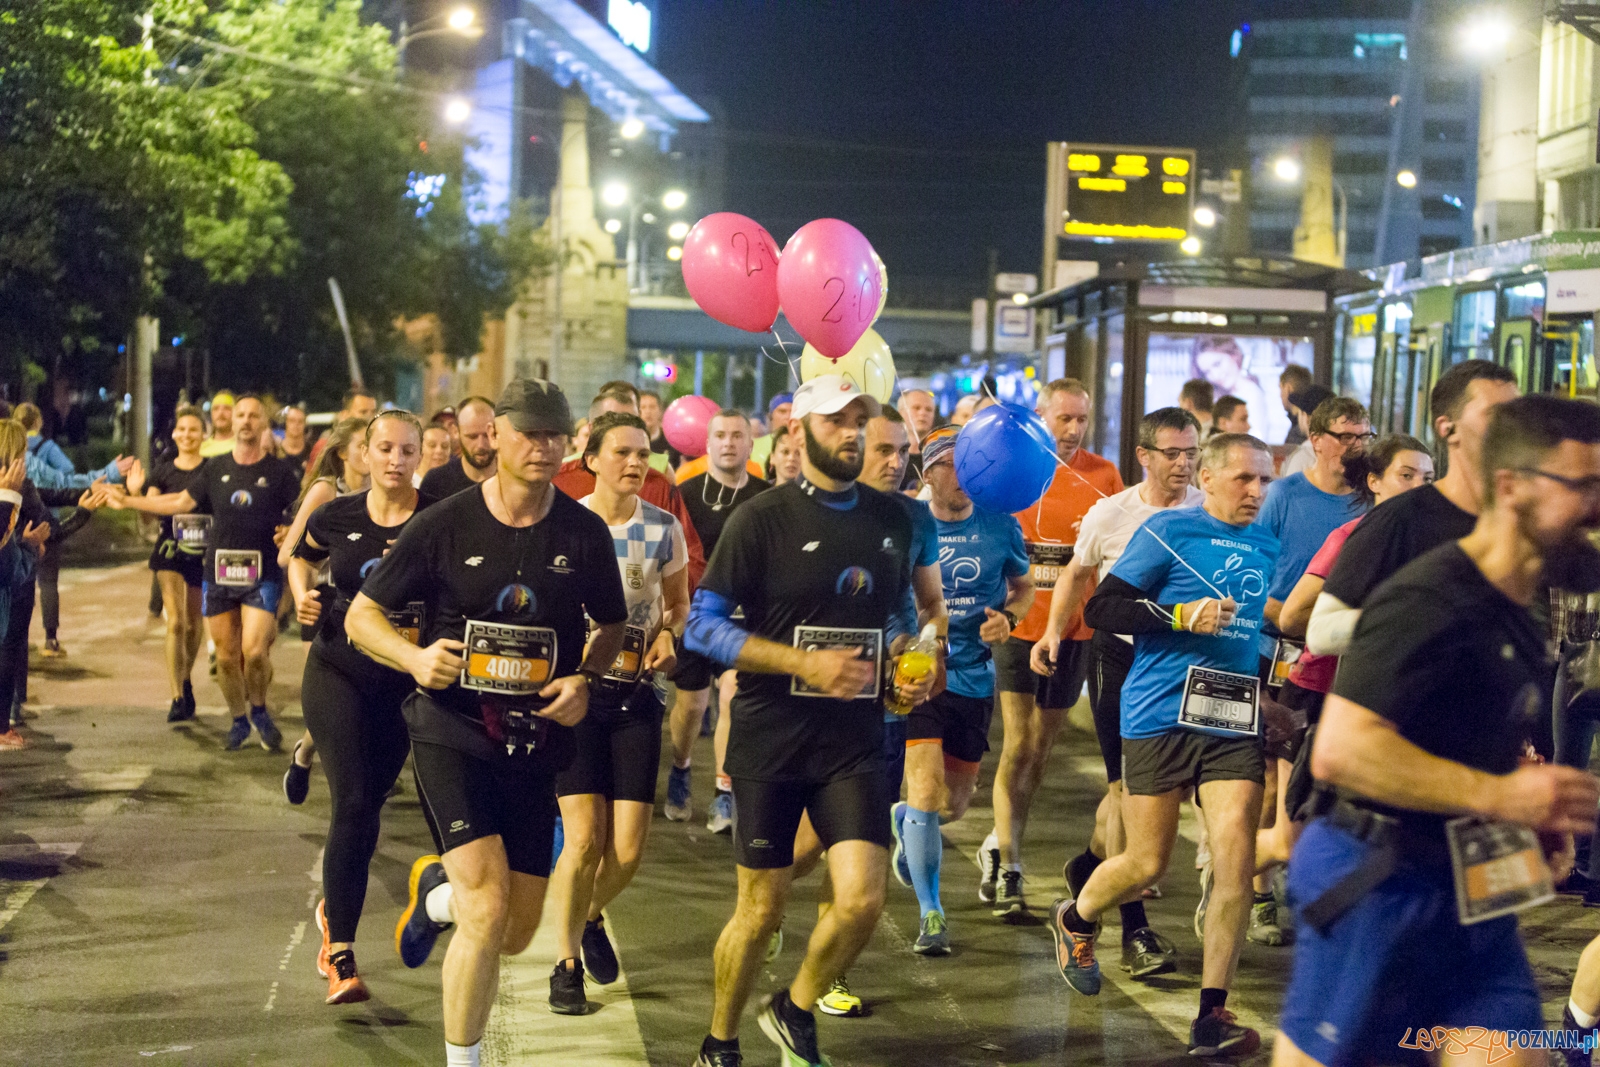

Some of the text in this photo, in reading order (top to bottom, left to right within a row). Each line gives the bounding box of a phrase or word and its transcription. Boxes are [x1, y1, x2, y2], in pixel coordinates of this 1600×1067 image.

[1210, 538, 1253, 553] PACEMAKER
[944, 596, 976, 606] NTRAKT
[1230, 617, 1259, 629] NTRAKT
[485, 657, 533, 680] 4002
[1200, 698, 1241, 720] 11509
